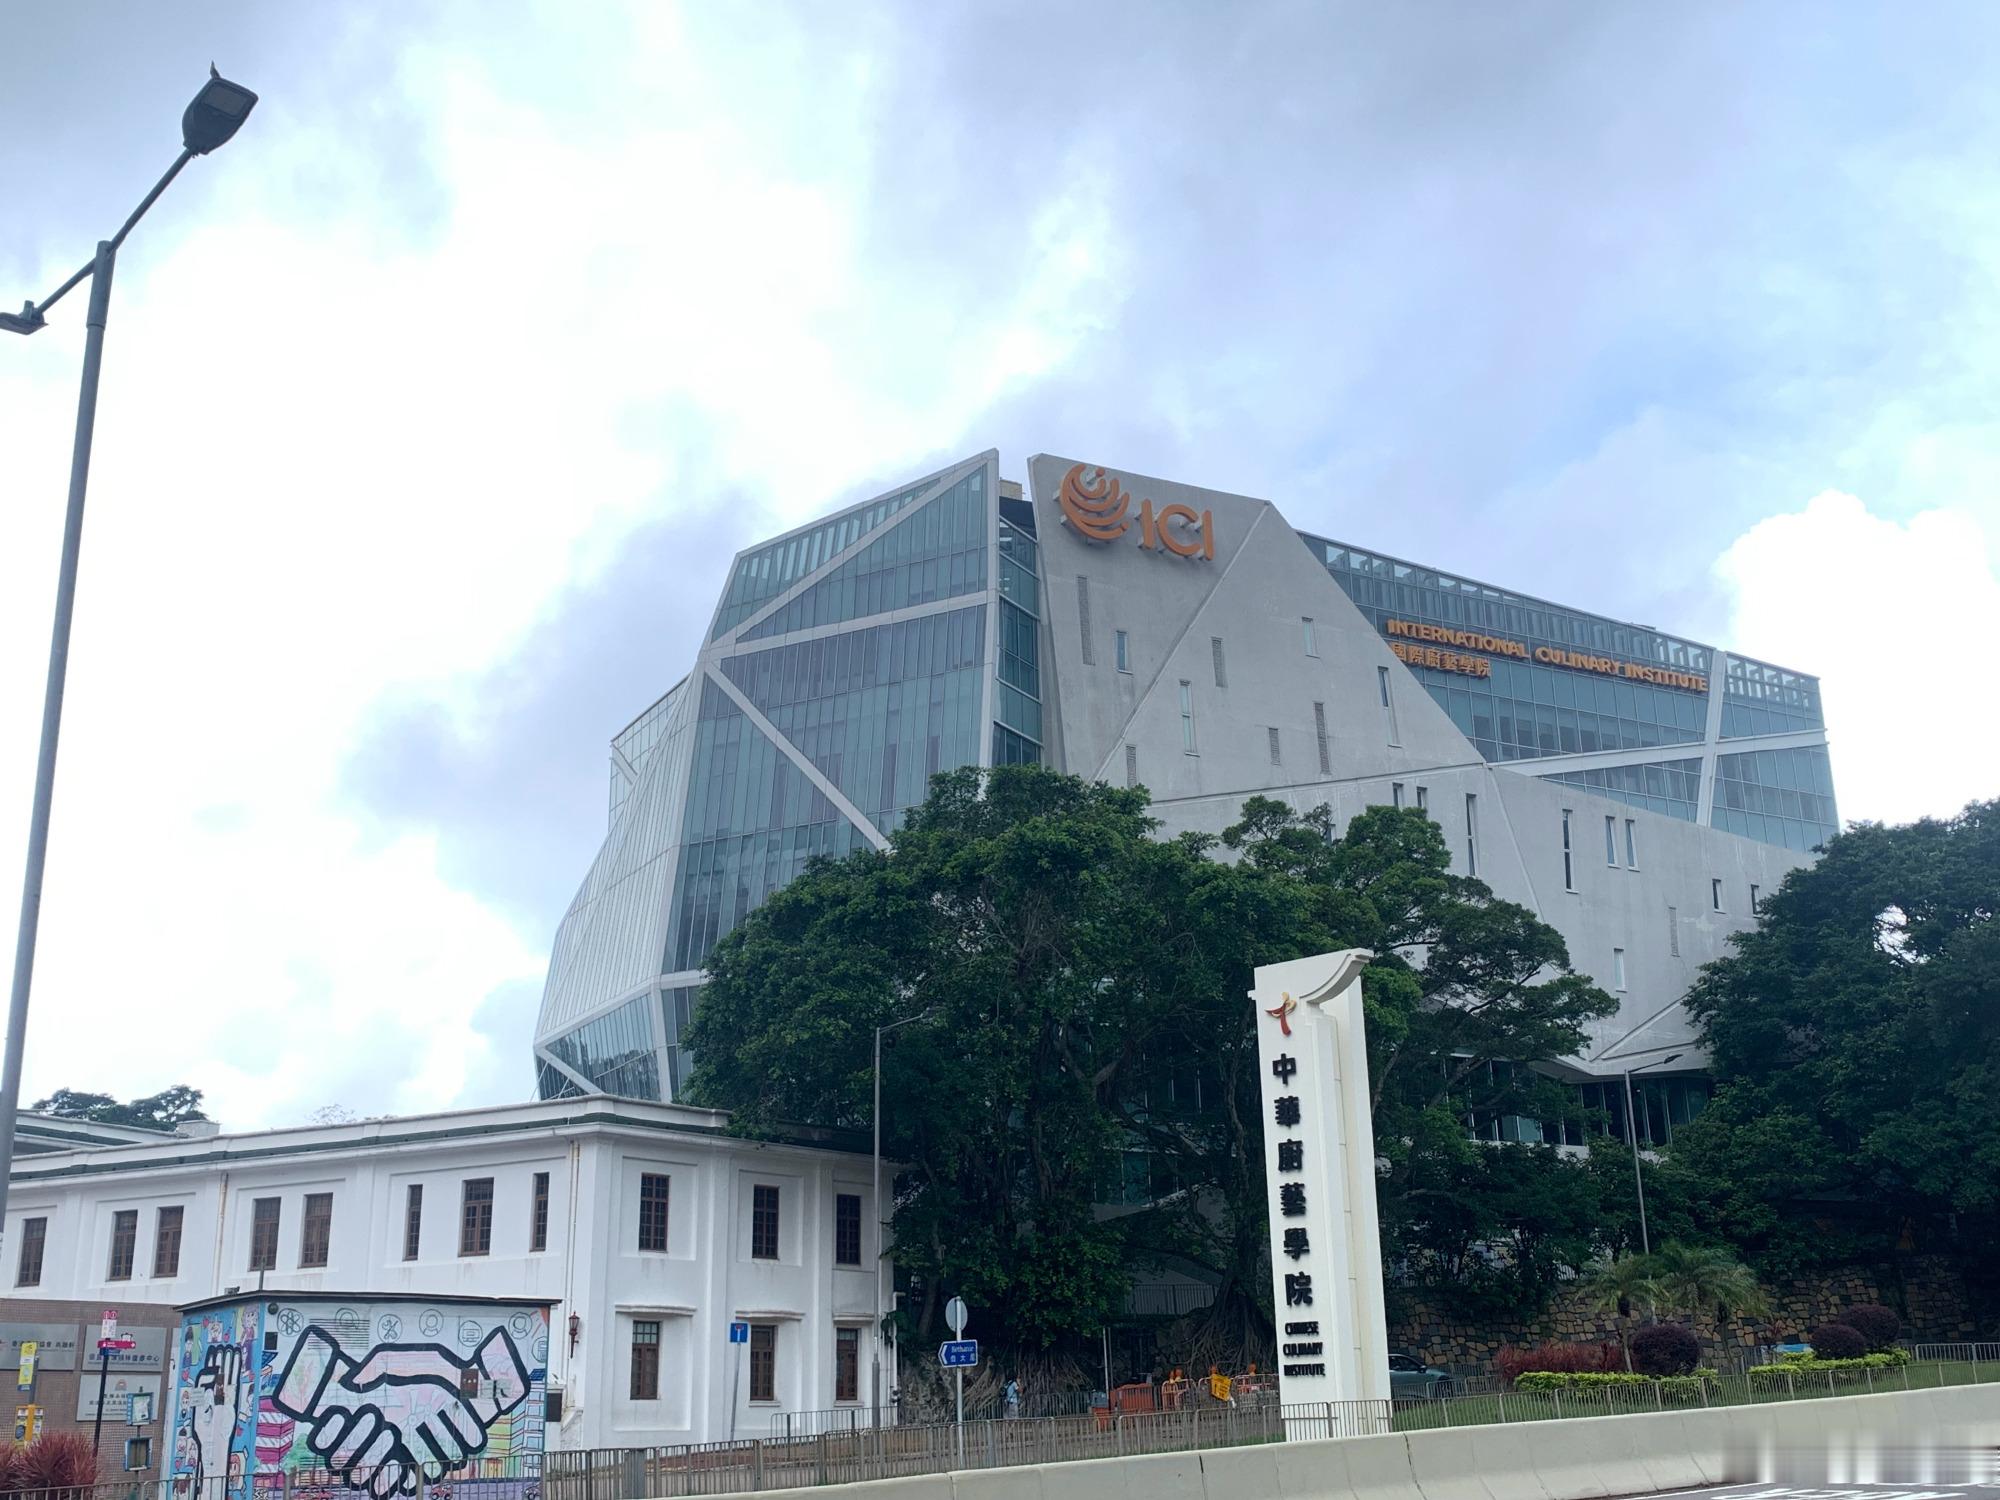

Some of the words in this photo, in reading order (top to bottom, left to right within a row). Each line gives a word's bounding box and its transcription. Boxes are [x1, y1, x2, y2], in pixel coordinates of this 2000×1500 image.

[1141, 498, 1215, 561] ICI
[1387, 618, 1531, 659] INTERNATIONAL
[1535, 646, 1621, 674] CULINARY
[1624, 663, 1709, 692] INSTITUTE
[1272, 1053, 1313, 1307] 中華廚藝學院
[1285, 1321, 1319, 1335] CHINESE
[1283, 1342, 1323, 1357] CULINARY
[1284, 1363, 1326, 1377] INSTITUTE
